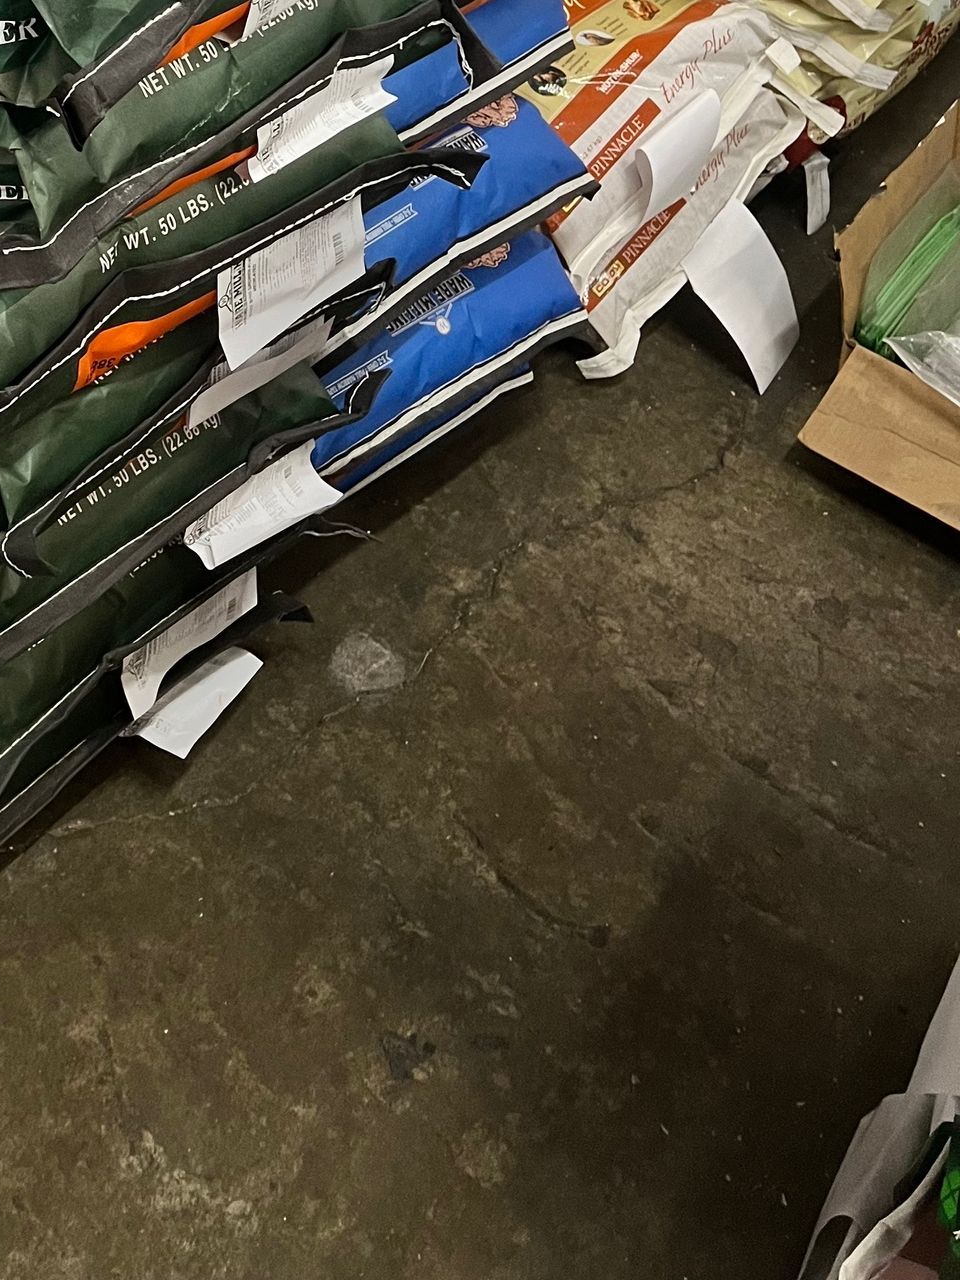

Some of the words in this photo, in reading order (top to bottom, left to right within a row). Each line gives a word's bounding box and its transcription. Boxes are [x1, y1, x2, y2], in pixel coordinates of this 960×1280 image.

[138, 67, 170, 98] NET
[171, 52, 201, 79] WT.
[200, 41, 218, 63] 50
[590, 115, 645, 178] PINNACLE
[123, 226, 157, 251] WT.
[158, 213, 177, 236] 50
[178, 193, 214, 223] LBS.
[622, 209, 672, 264] PINNACLE
[437, 272, 475, 306] WARE
[131, 448, 163, 477] LBS.
